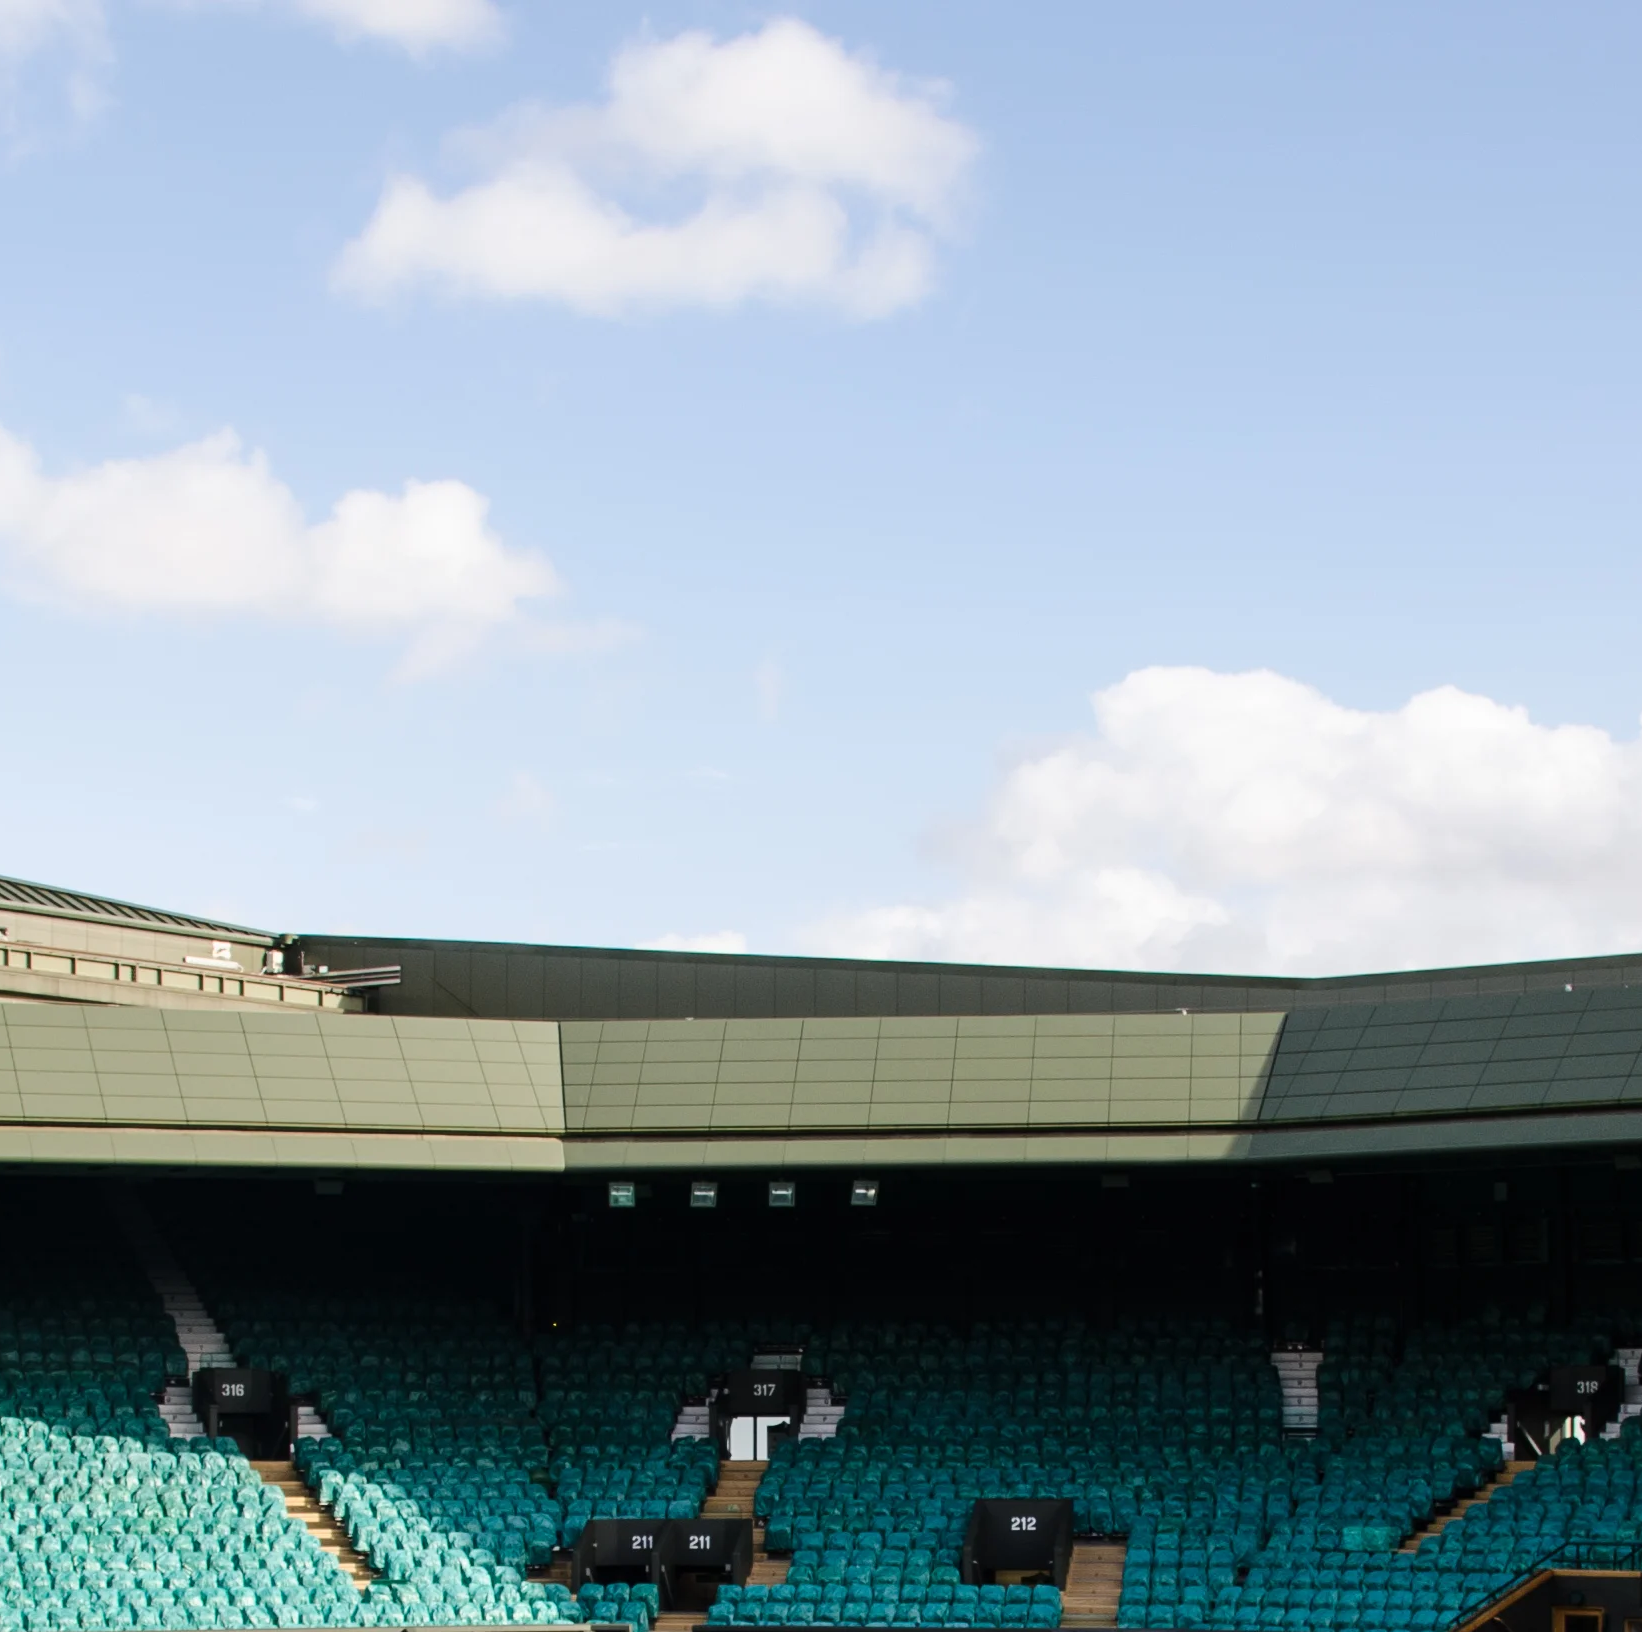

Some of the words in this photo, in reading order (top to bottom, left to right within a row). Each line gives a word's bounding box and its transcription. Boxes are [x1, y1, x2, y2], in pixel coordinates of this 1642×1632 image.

[221, 1383, 245, 1397] 316
[753, 1383, 776, 1397] 317
[1576, 1380, 1599, 1394] 318
[1011, 1516, 1037, 1531] 212
[631, 1535, 653, 1550] 211
[689, 1535, 711, 1550] 211
